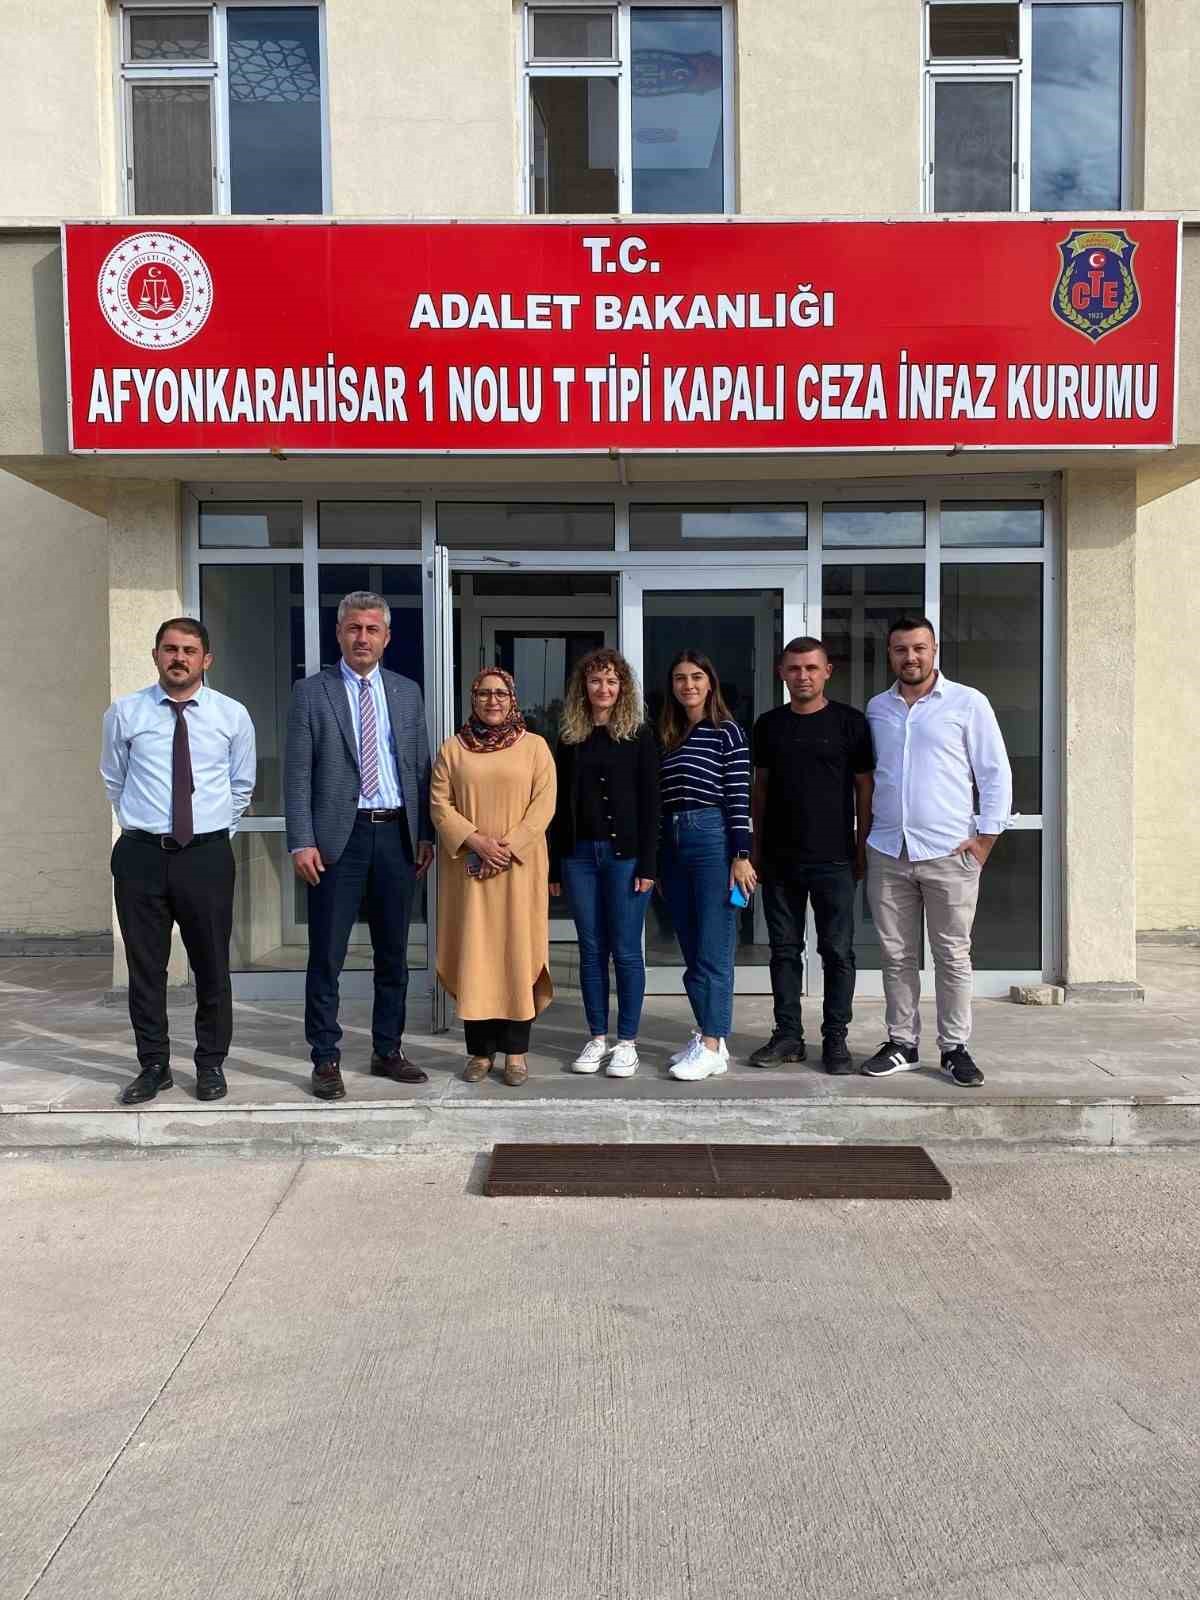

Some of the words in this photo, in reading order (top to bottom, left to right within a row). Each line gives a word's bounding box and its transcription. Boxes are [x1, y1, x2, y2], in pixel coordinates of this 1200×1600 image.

[582, 237, 660, 273] T.C.
[409, 293, 581, 330] ADALET
[595, 284, 834, 330] BAKANLIĞI
[87, 353, 408, 424] AFYONKARAHİSAR
[418, 366, 434, 422] 1
[448, 366, 542, 423] NOLU
[553, 367, 575, 422] T
[585, 353, 651, 422] TİPİ
[663, 365, 785, 422] KAPALI
[797, 364, 887, 421] CEZA
[898, 351, 996, 419] İNFAZ
[1007, 364, 1158, 420] KURUMU
